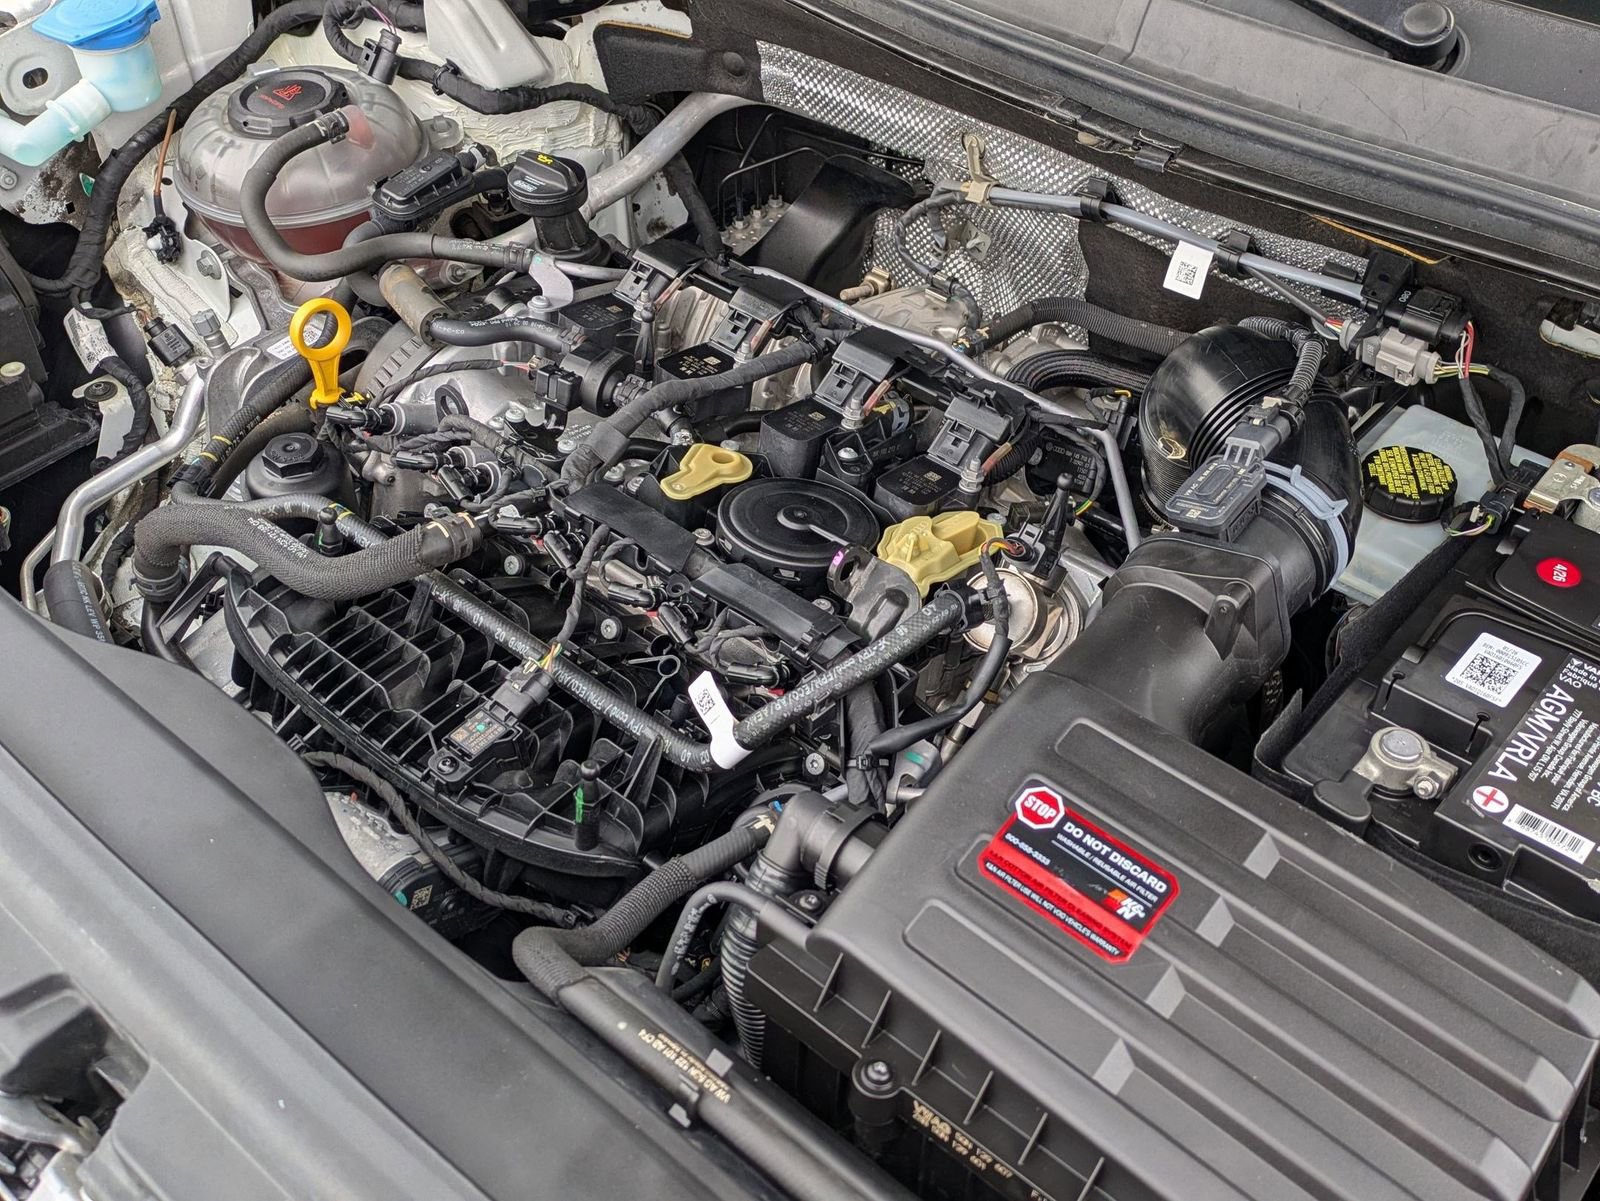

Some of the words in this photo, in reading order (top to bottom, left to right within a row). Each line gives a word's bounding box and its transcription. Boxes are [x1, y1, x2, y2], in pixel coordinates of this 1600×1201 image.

[1553, 564, 1568, 582] 4/26
[1561, 666, 1598, 690] Fabriqué
[1565, 662, 1588, 677] Made
[1588, 673, 1597, 681] in
[1488, 684, 1575, 783] AGM/VRLA
[1024, 795, 1057, 820] STOP
[1054, 832, 1091, 858] WASHABLE
[1090, 856, 1126, 881] REUSABLE
[1123, 877, 1137, 889] AIR
[1134, 885, 1158, 903] FILTER
[1063, 821, 1082, 839] DO
[1083, 833, 1111, 856] NOT
[1109, 848, 1168, 893] DISCARD
[1003, 873, 1022, 889] FILTER
[1041, 899, 1054, 911] NOT
[1051, 907, 1066, 920] VOID
[1088, 932, 1120, 956] WARRANTY
